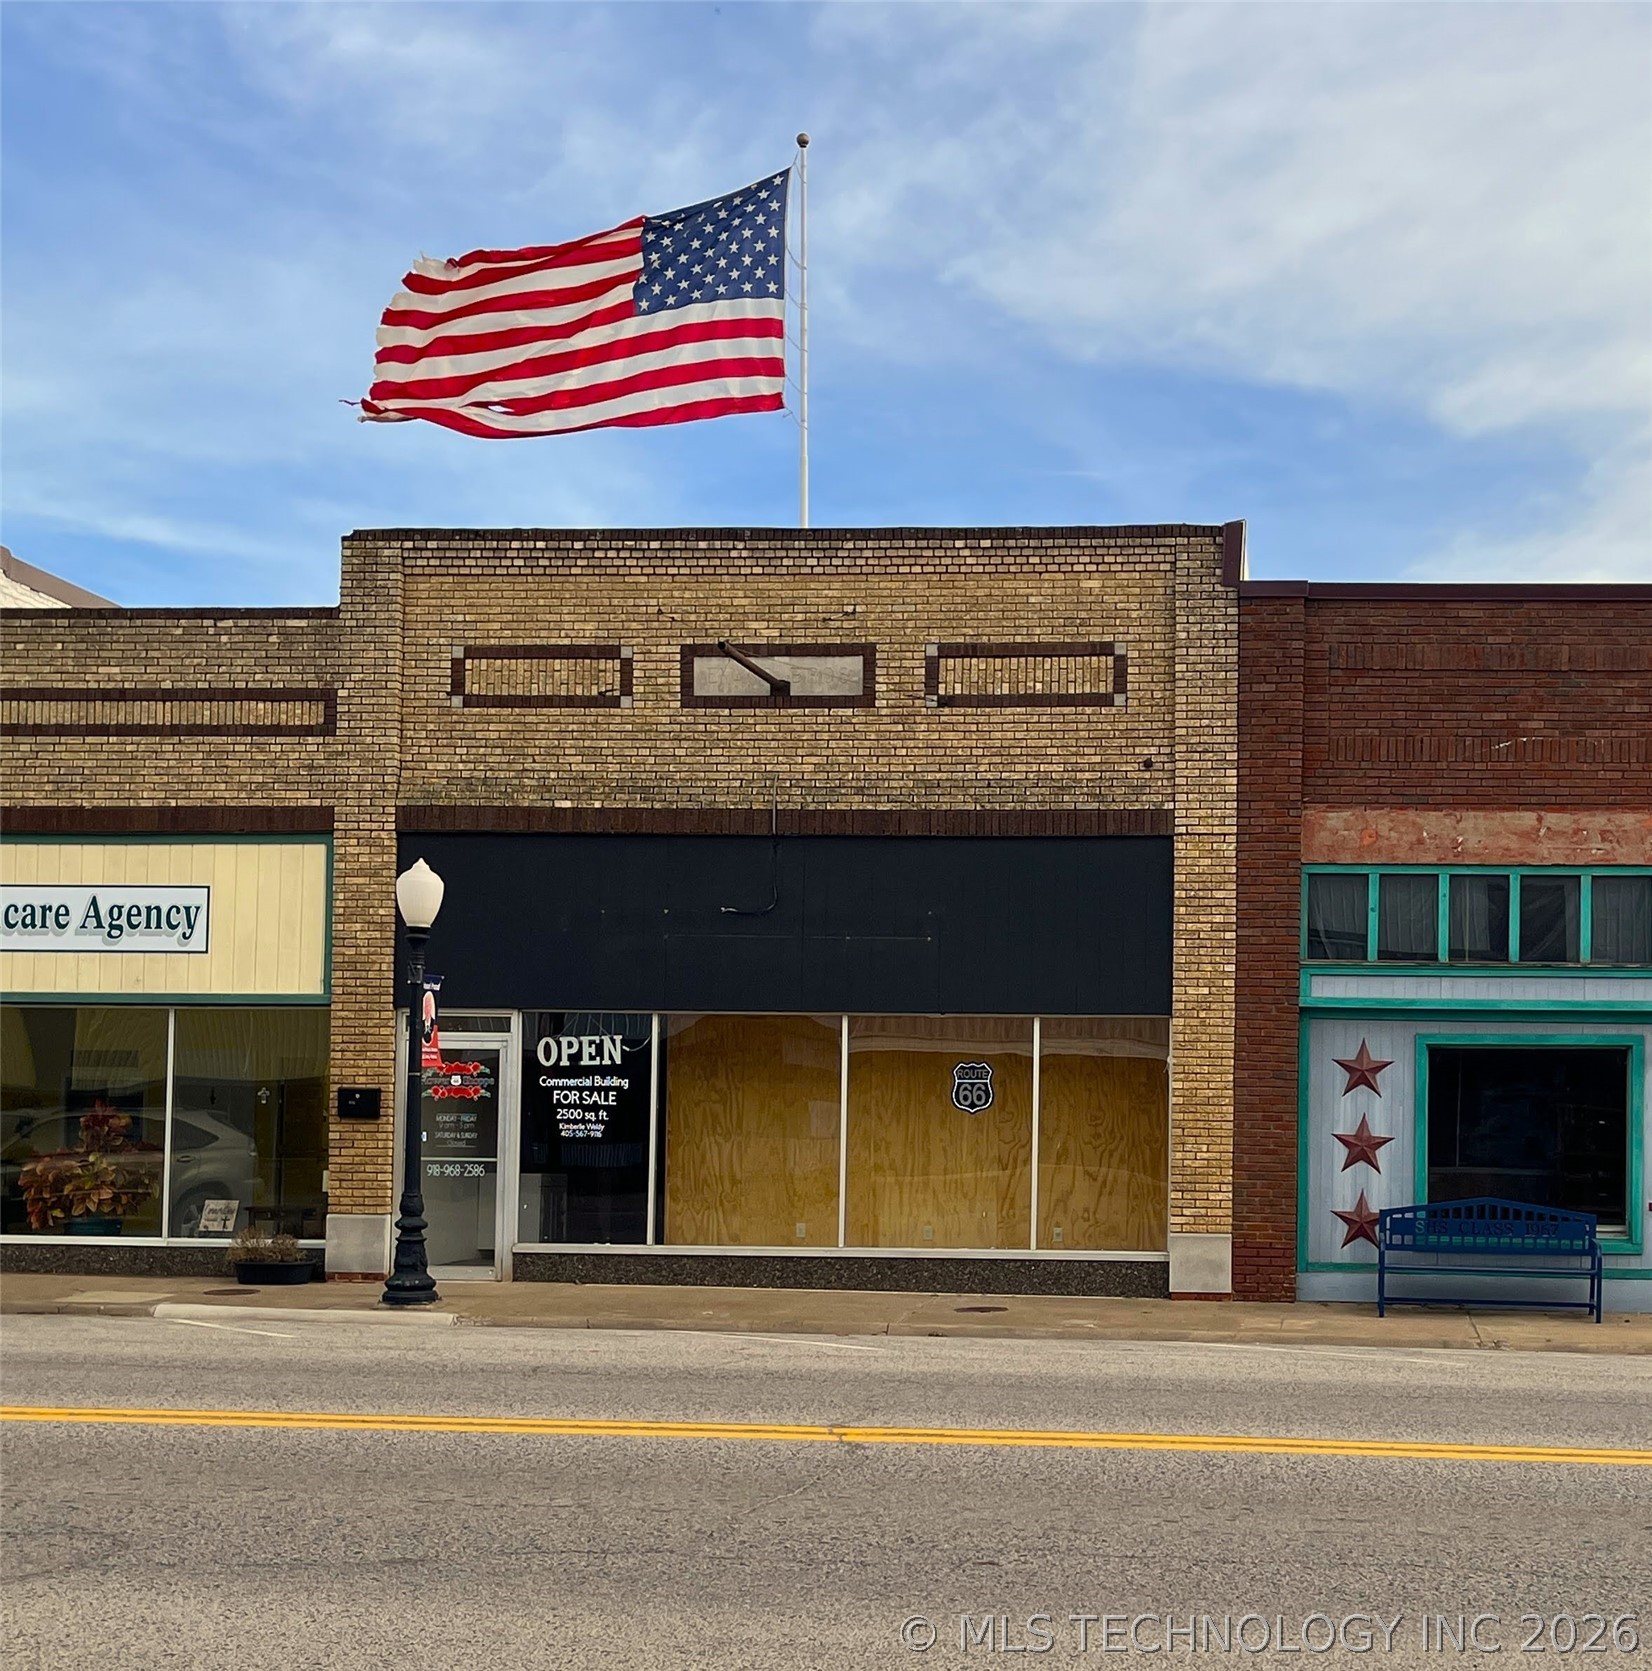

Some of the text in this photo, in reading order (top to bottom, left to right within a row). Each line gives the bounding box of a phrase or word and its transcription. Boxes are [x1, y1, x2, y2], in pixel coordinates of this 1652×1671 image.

[0, 895, 201, 940] care Agency
[537, 1035, 623, 1067] OPEN
[957, 1069, 988, 1079] ROUTE
[539, 1075, 629, 1090] Commercial Building
[553, 1090, 617, 1106] FOR SALE
[959, 1083, 986, 1106] 66
[556, 1109, 583, 1120] 2500
[426, 1164, 486, 1177] 918-968-2586
[1415, 1220, 1447, 1234] SHS
[1459, 1221, 1514, 1236] CLASS
